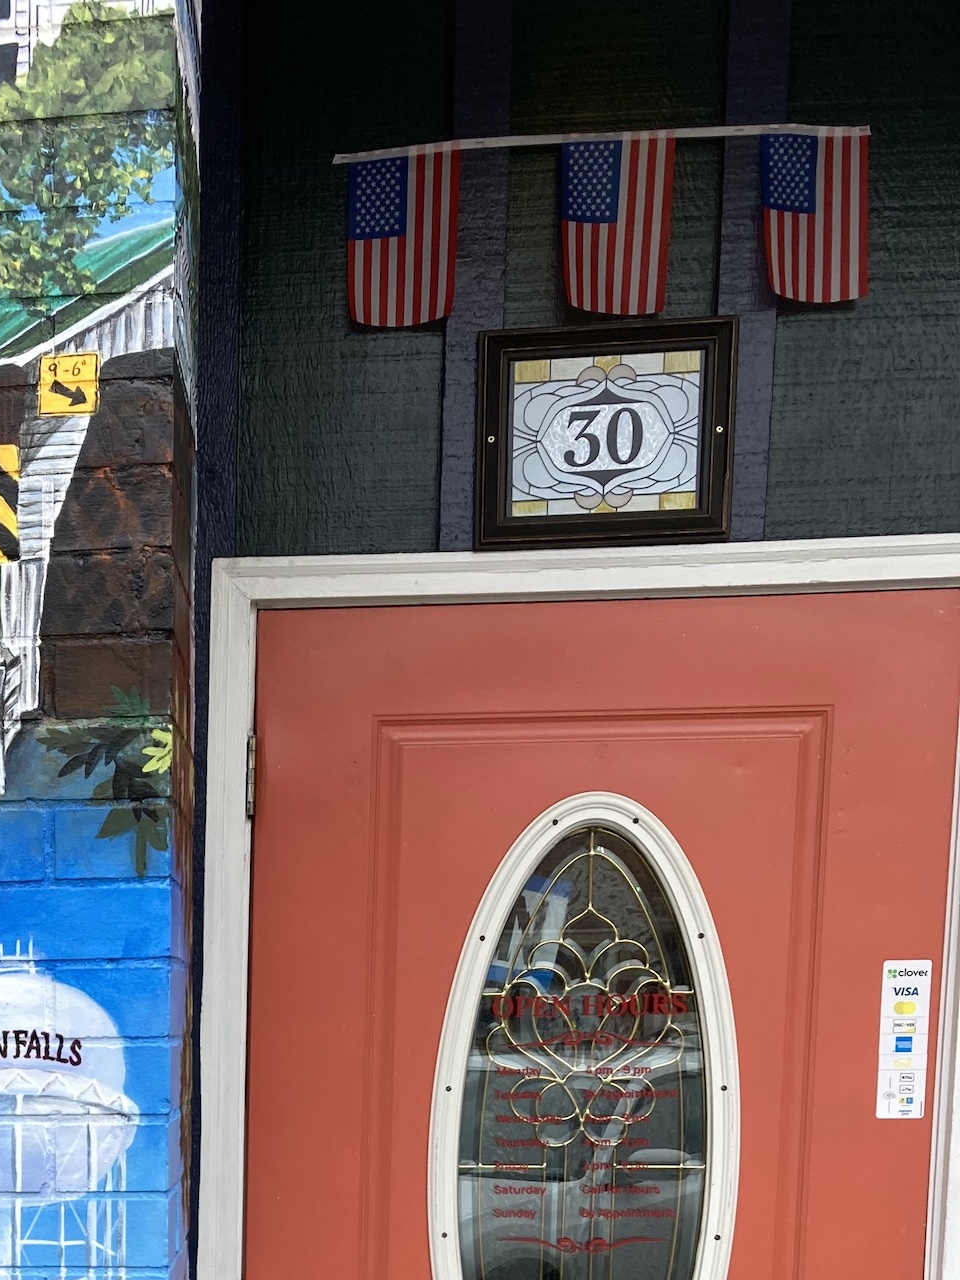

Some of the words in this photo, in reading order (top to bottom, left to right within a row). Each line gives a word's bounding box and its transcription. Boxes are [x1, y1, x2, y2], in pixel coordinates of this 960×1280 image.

[563, 407, 644, 468] 30
[898, 968, 929, 977] clover
[892, 987, 919, 996] VISA
[492, 994, 571, 1019] OPEN
[581, 993, 689, 1017] HOURS
[13, 1029, 83, 1067] FALLS
[495, 1066, 542, 1078] Monday
[623, 1065, 631, 1075] 9
[633, 1067, 652, 1079] pm
[495, 1090, 542, 1101] Tuesday
[495, 1115, 563, 1126] Wednesday
[495, 1138, 549, 1150] Thursday
[494, 1160, 529, 1173] Friday
[493, 1185, 547, 1197] Saturday
[493, 1208, 537, 1220] Sunday
